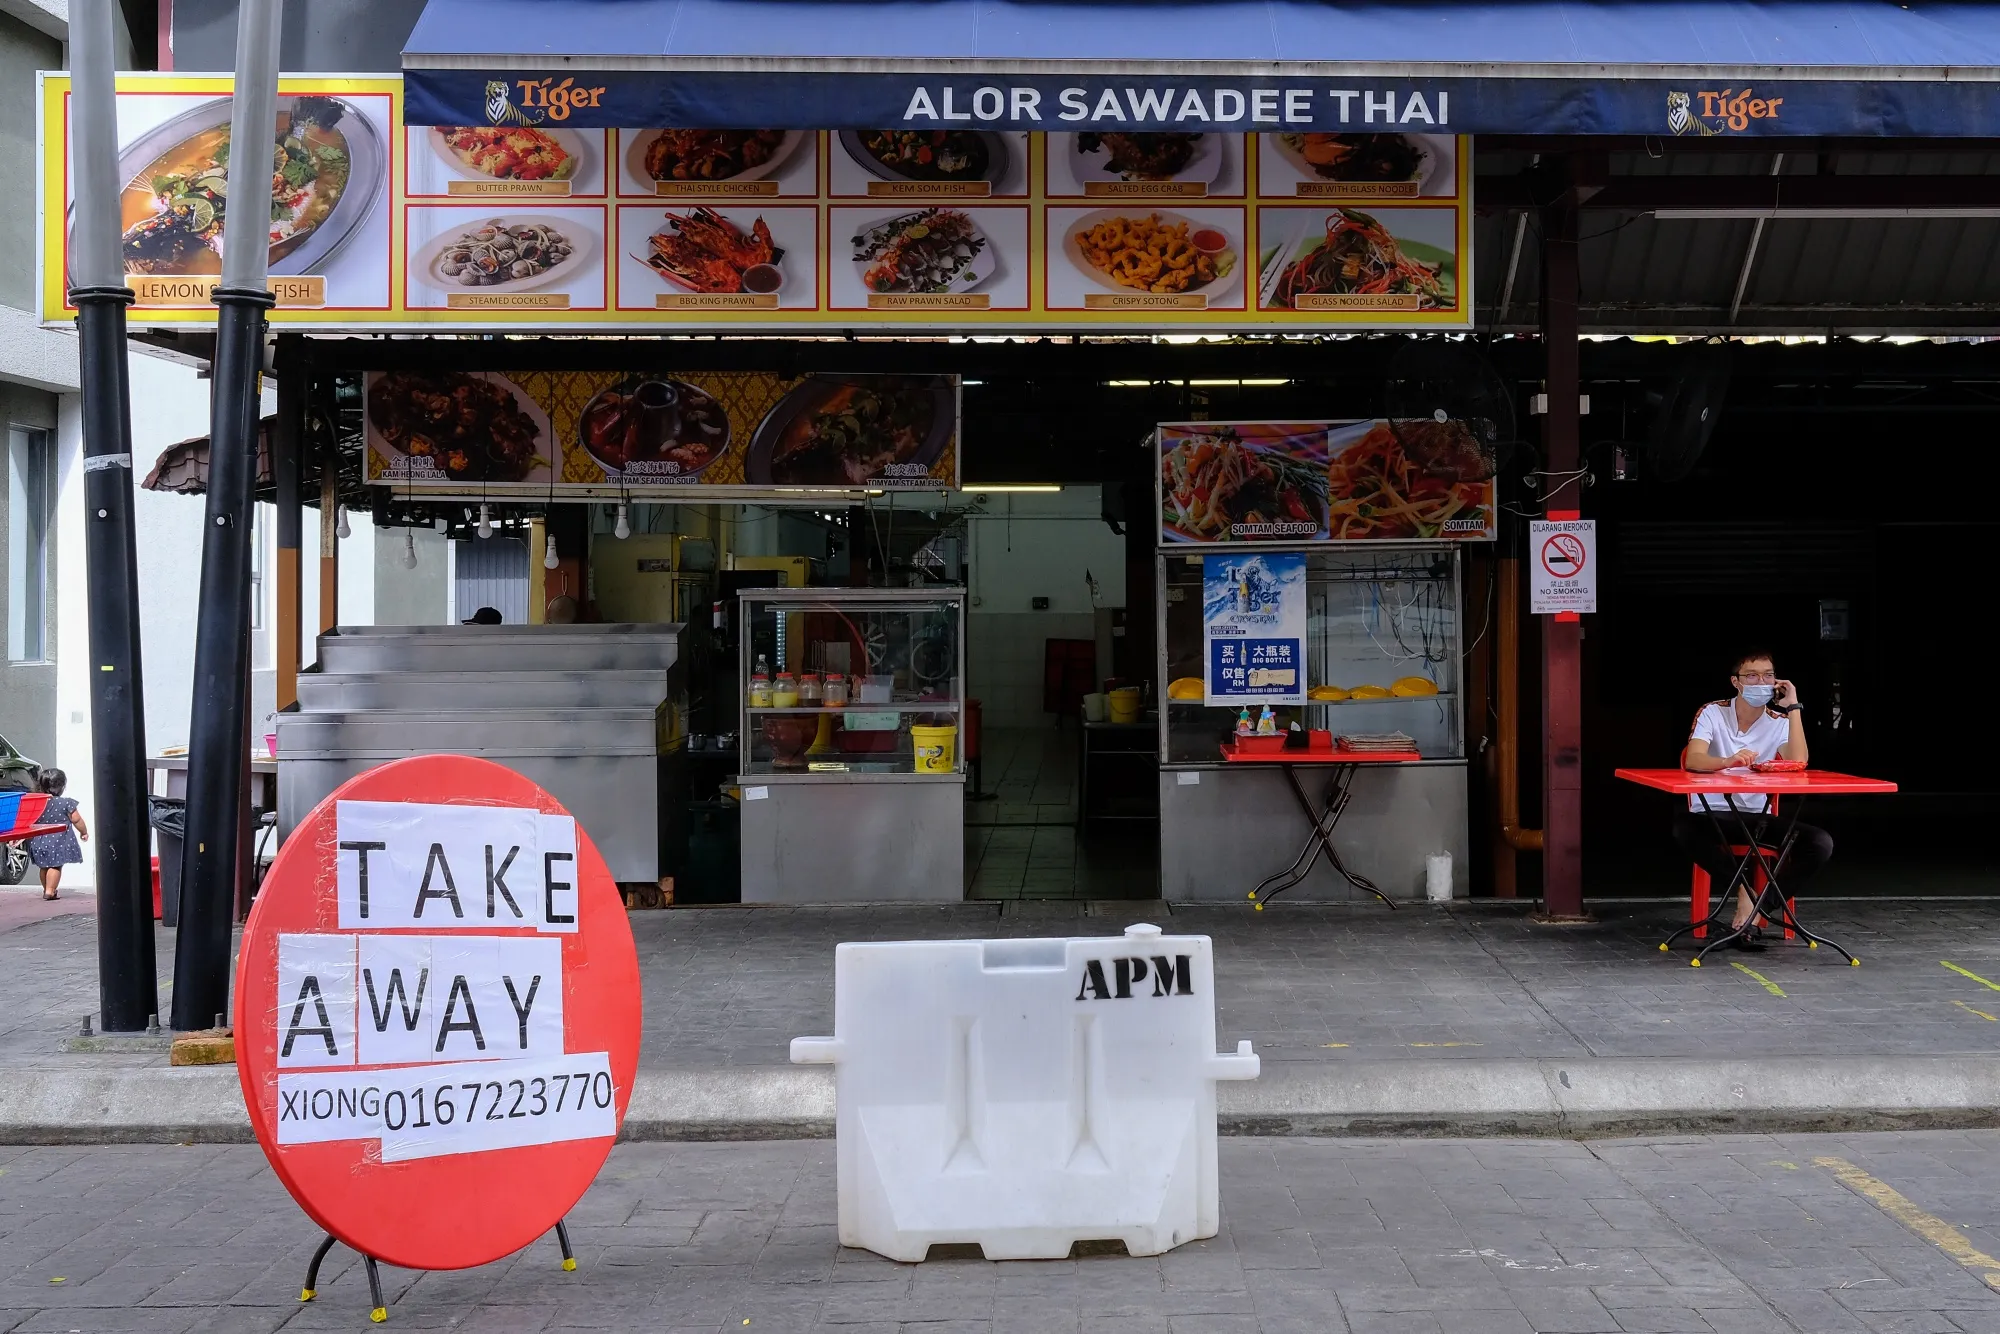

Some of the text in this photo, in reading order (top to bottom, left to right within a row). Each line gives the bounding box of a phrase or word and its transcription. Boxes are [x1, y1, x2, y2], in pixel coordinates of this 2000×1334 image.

[516, 77, 606, 121] Tiger
[903, 86, 1448, 125] ALOR SAWADEE THAI
[1696, 88, 1784, 131] Tiger
[476, 184, 543, 193] BUTTER PRAWN
[675, 184, 760, 193] THAI STYLE CHICKEN
[892, 184, 966, 193] KEM SOM FISH
[1108, 184, 1184, 193] SALTED EGG CRAB
[1300, 185, 1414, 193] CRAB WITH GLASS NOODLE
[142, 283, 204, 298] LEMON
[274, 283, 310, 298] FISH
[469, 297, 549, 305] STEAMED COCKLES
[679, 297, 755, 305] BBQ KING PRAWN
[887, 297, 971, 305] RAW PRAWN SALAD
[1112, 297, 1179, 305] CRISPY SOTONG
[625, 461, 680, 474] 东炎海鲜汤
[884, 464, 928, 476] 东炎蒸鱼
[382, 470, 446, 480] KAM HEONG LALA
[640, 476, 674, 485] SEAFOOD
[676, 477, 696, 485] SOUP
[1232, 523, 1316, 534] SOMTAM SEAFOOD
[1444, 520, 1484, 531] SOMTAM
[1532, 522, 1593, 532] DILARANG MEROKOK
[1550, 580, 1579, 588] 禁止吸烟
[1553, 587, 1588, 595] SMOKING
[1222, 645, 1291, 657] 买 大瓶装
[1222, 667, 1245, 679] 仅售
[1232, 679, 1245, 687] RM
[339, 841, 575, 924] TAKE
[1075, 954, 1195, 1001] APM
[280, 968, 542, 1058] AWAY
[280, 1071, 613, 1131] XIONG 0167223770
